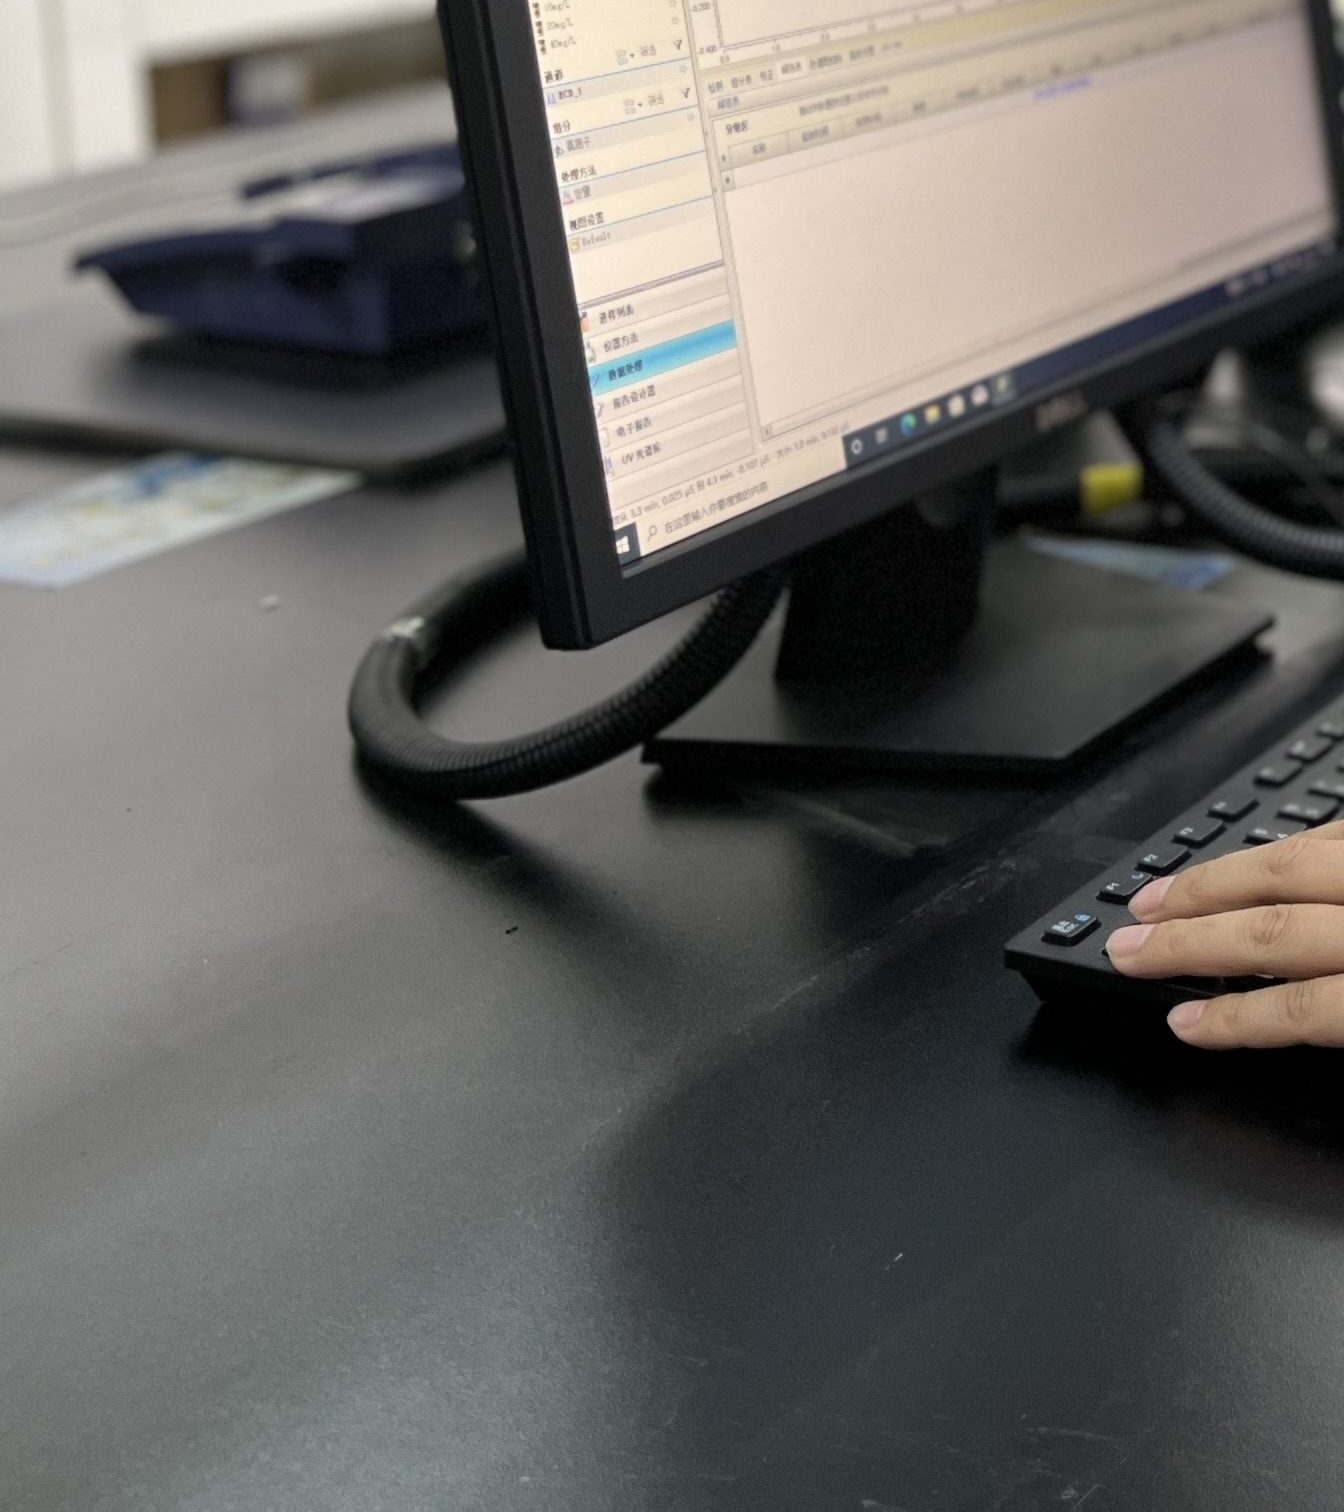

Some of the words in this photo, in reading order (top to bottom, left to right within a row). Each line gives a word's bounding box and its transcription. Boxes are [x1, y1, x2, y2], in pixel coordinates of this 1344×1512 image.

[561, 165, 596, 182] 处理方法
[569, 212, 603, 230] 视图设置
[582, 230, 610, 246] Default
[604, 332, 638, 352] 仪器方法
[608, 360, 643, 380] 数据处理
[613, 385, 655, 409] 报告设计器
[617, 416, 651, 437] 电子报告
[622, 452, 633, 464] UV
[635, 442, 660, 460] 光谱库
[665, 480, 767, 534] 在这里输入你要搜索的内容
[1179, 827, 1194, 836] F3
[1143, 853, 1158, 863] F2
[1106, 882, 1121, 891] F1
